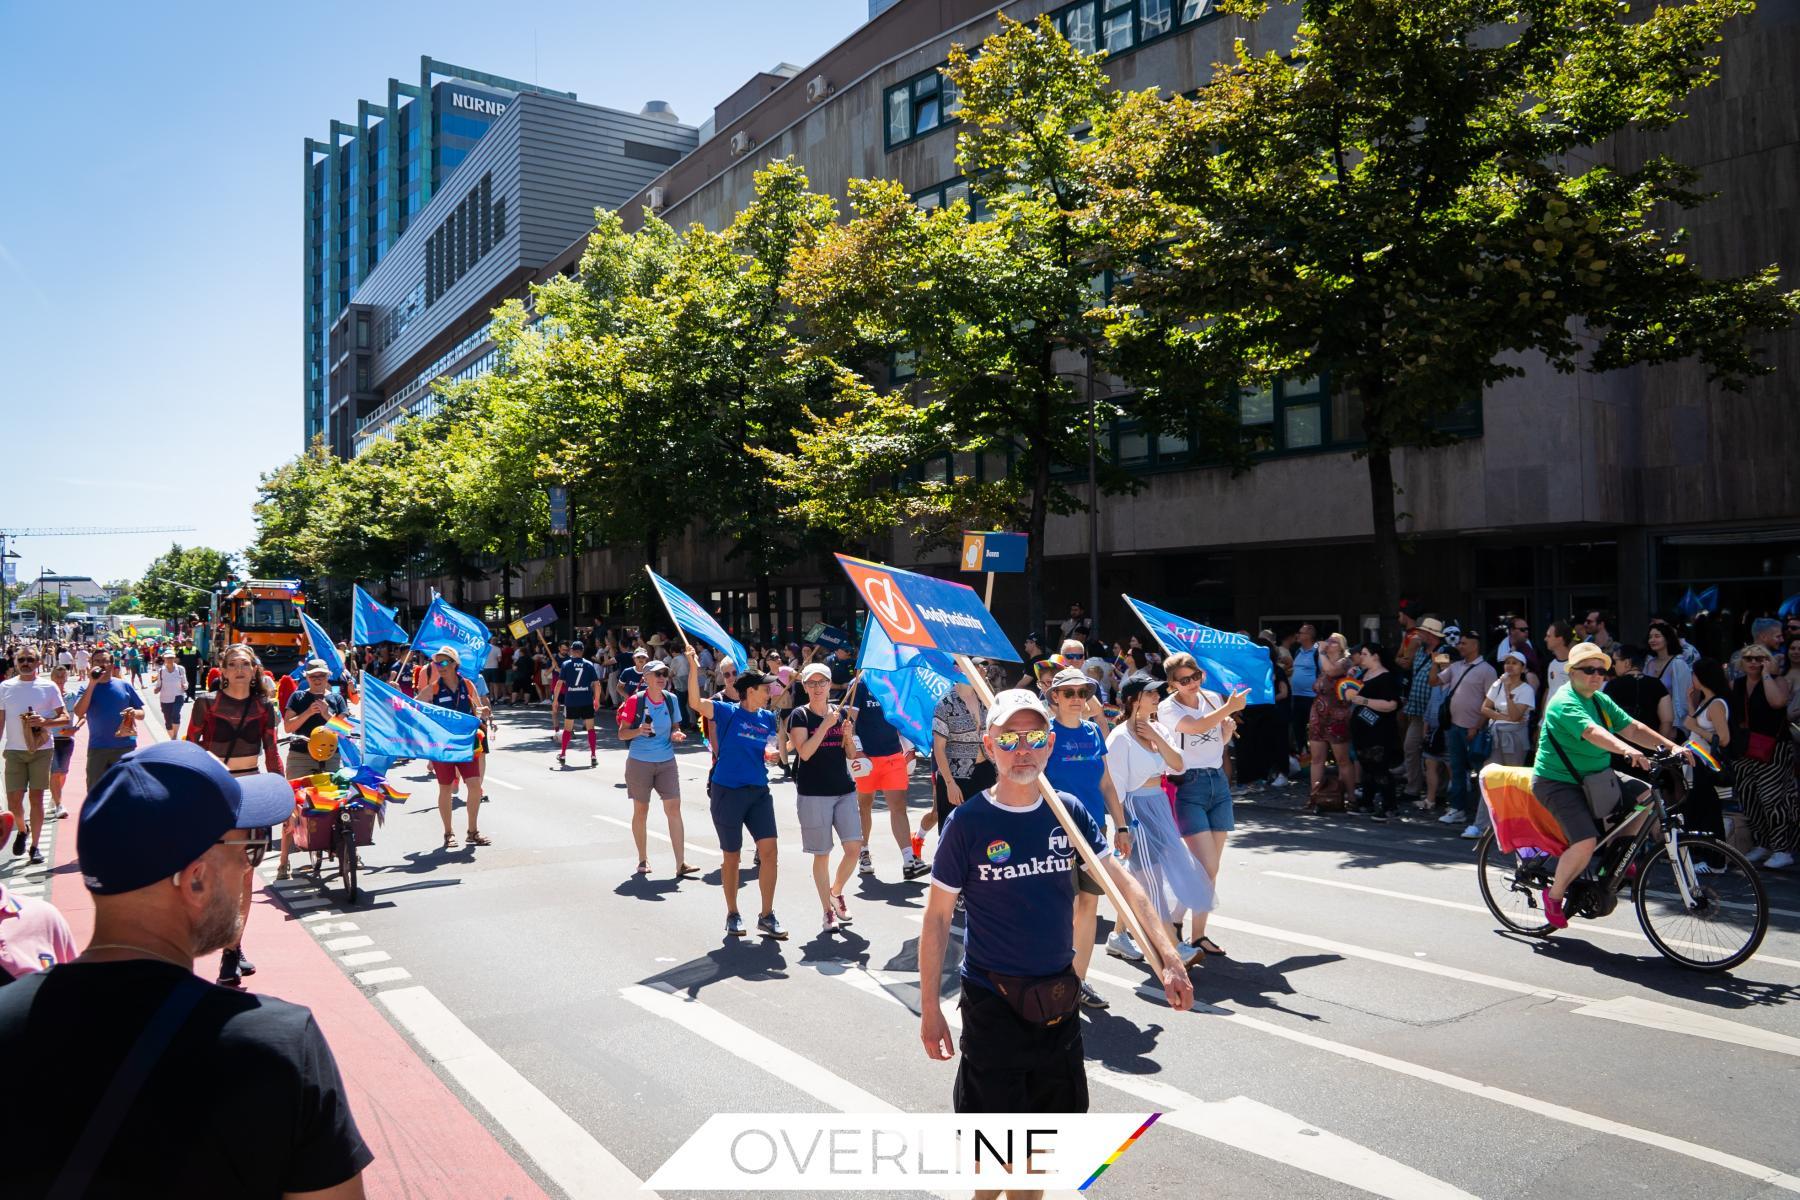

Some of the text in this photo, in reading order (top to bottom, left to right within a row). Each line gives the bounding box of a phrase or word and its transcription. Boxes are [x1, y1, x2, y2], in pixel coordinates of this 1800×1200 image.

[915, 603, 986, 634] BodyPositivity
[574, 667, 584, 687] 7
[977, 855, 1077, 881] Frankfur
[1614, 842, 1637, 878] PEGASUS
